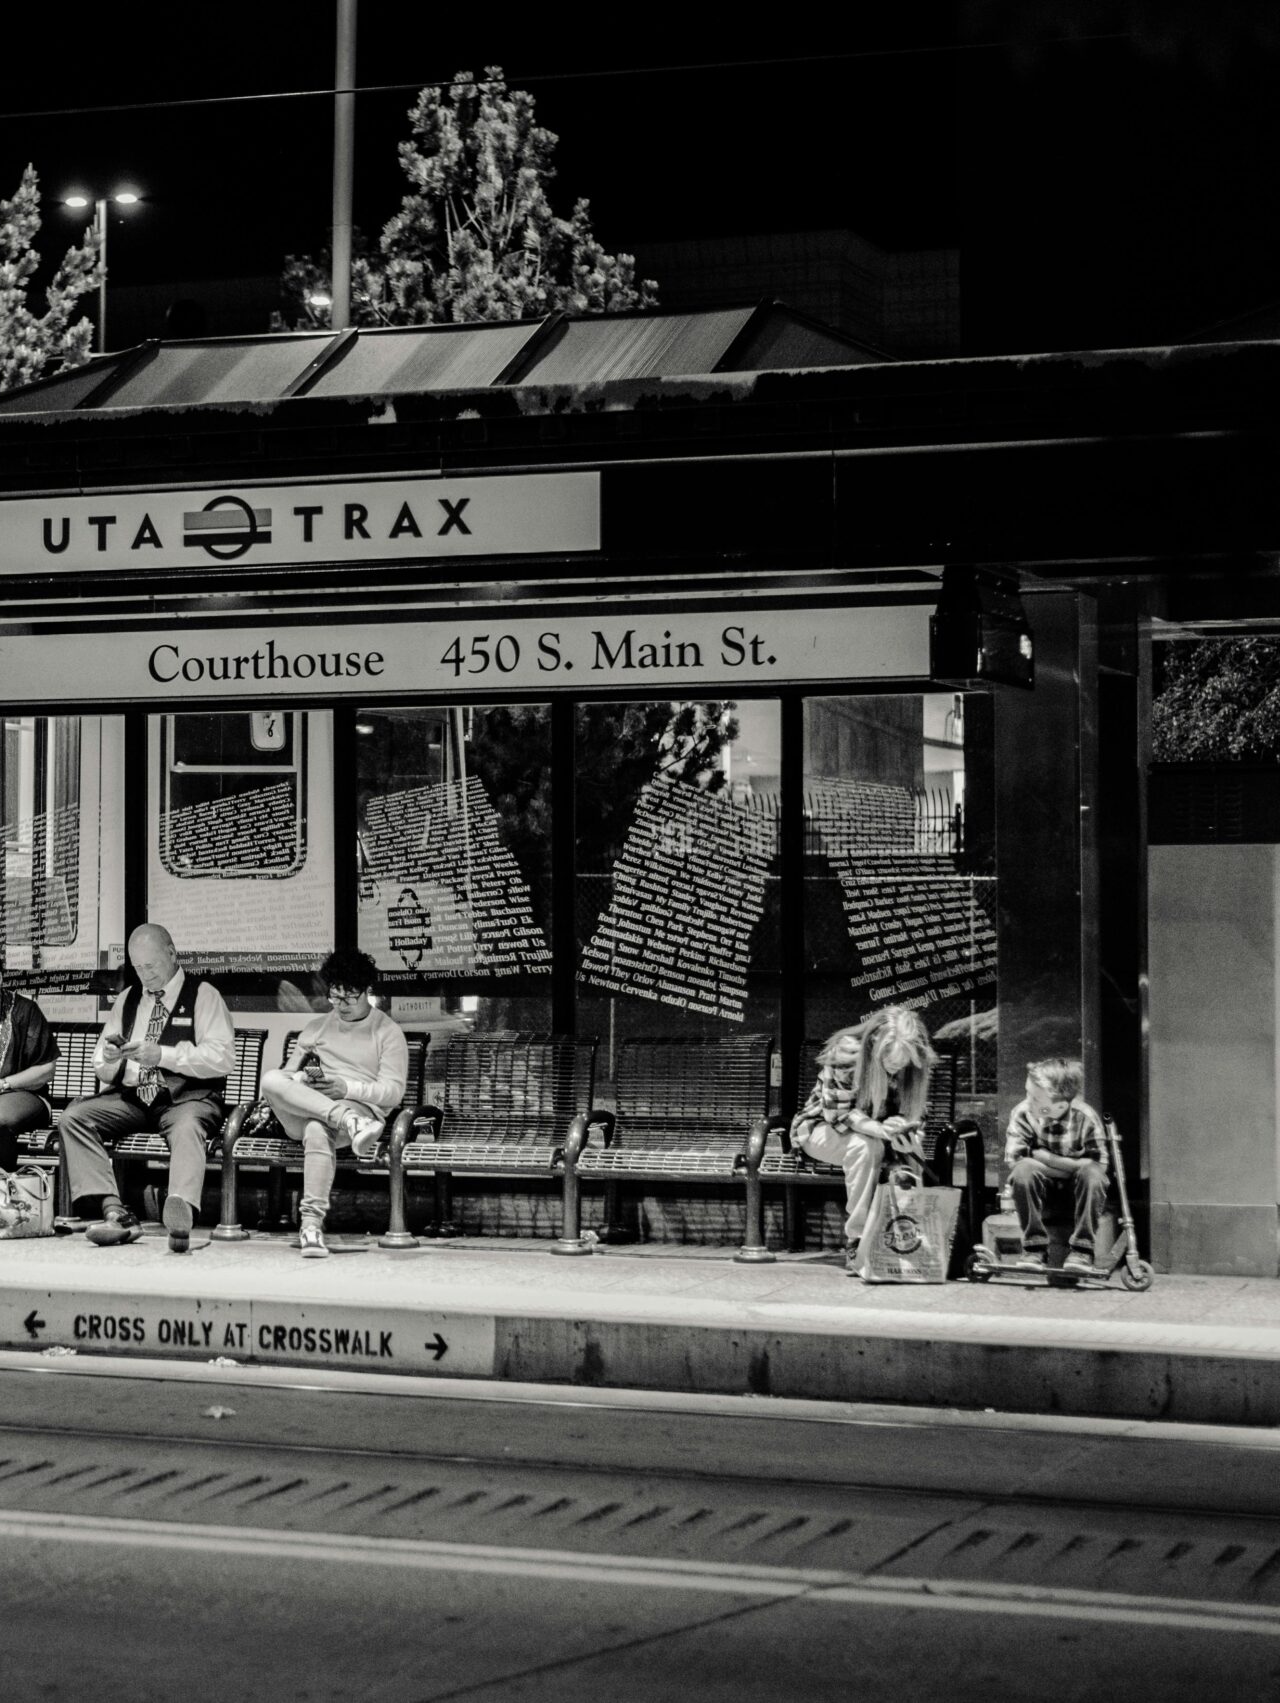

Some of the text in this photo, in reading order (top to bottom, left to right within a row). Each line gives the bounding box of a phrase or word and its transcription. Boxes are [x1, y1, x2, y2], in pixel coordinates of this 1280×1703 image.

[42, 497, 473, 554] UTA TRAX
[147, 625, 778, 684] Courthouse 450 S. Main St.
[671, 889, 696, 903] Stanley
[490, 907, 533, 916] Buchanan
[521, 916, 533, 924] Ek
[598, 913, 617, 924] Ross
[608, 904, 642, 919] Thornton
[646, 915, 664, 926] Chen
[667, 921, 683, 932] Park
[686, 927, 717, 941] Stephens
[720, 915, 753, 930] Robertson
[395, 936, 428, 946] Holladay
[513, 927, 543, 936] Gilson
[473, 943, 493, 952] Urry
[532, 938, 546, 946] Us
[591, 936, 615, 950] Quinn
[618, 943, 639, 954] Snow
[642, 950, 674, 965] Marshall
[677, 959, 714, 976] Kovalenko
[647, 939, 676, 953] Webster
[679, 948, 705, 961] Perkins
[708, 956, 747, 973] Richardson
[383, 973, 417, 981] Brewster
[524, 965, 552, 974] Terry
[582, 946, 609, 960] Kelson
[658, 967, 685, 980] Benson
[719, 983, 748, 998] Simpson
[611, 967, 630, 980] They
[633, 973, 655, 985] Orlov
[698, 990, 716, 1002] Pratt
[869, 986, 897, 1001] Gomez
[398, 1000, 432, 1012] AUTHORITY
[589, 975, 619, 990] Newton
[621, 984, 657, 1000] Cervenka
[719, 1009, 744, 1022] Arnold
[73, 1313, 393, 1358] CROSS ONLY AT CROSSWALK
